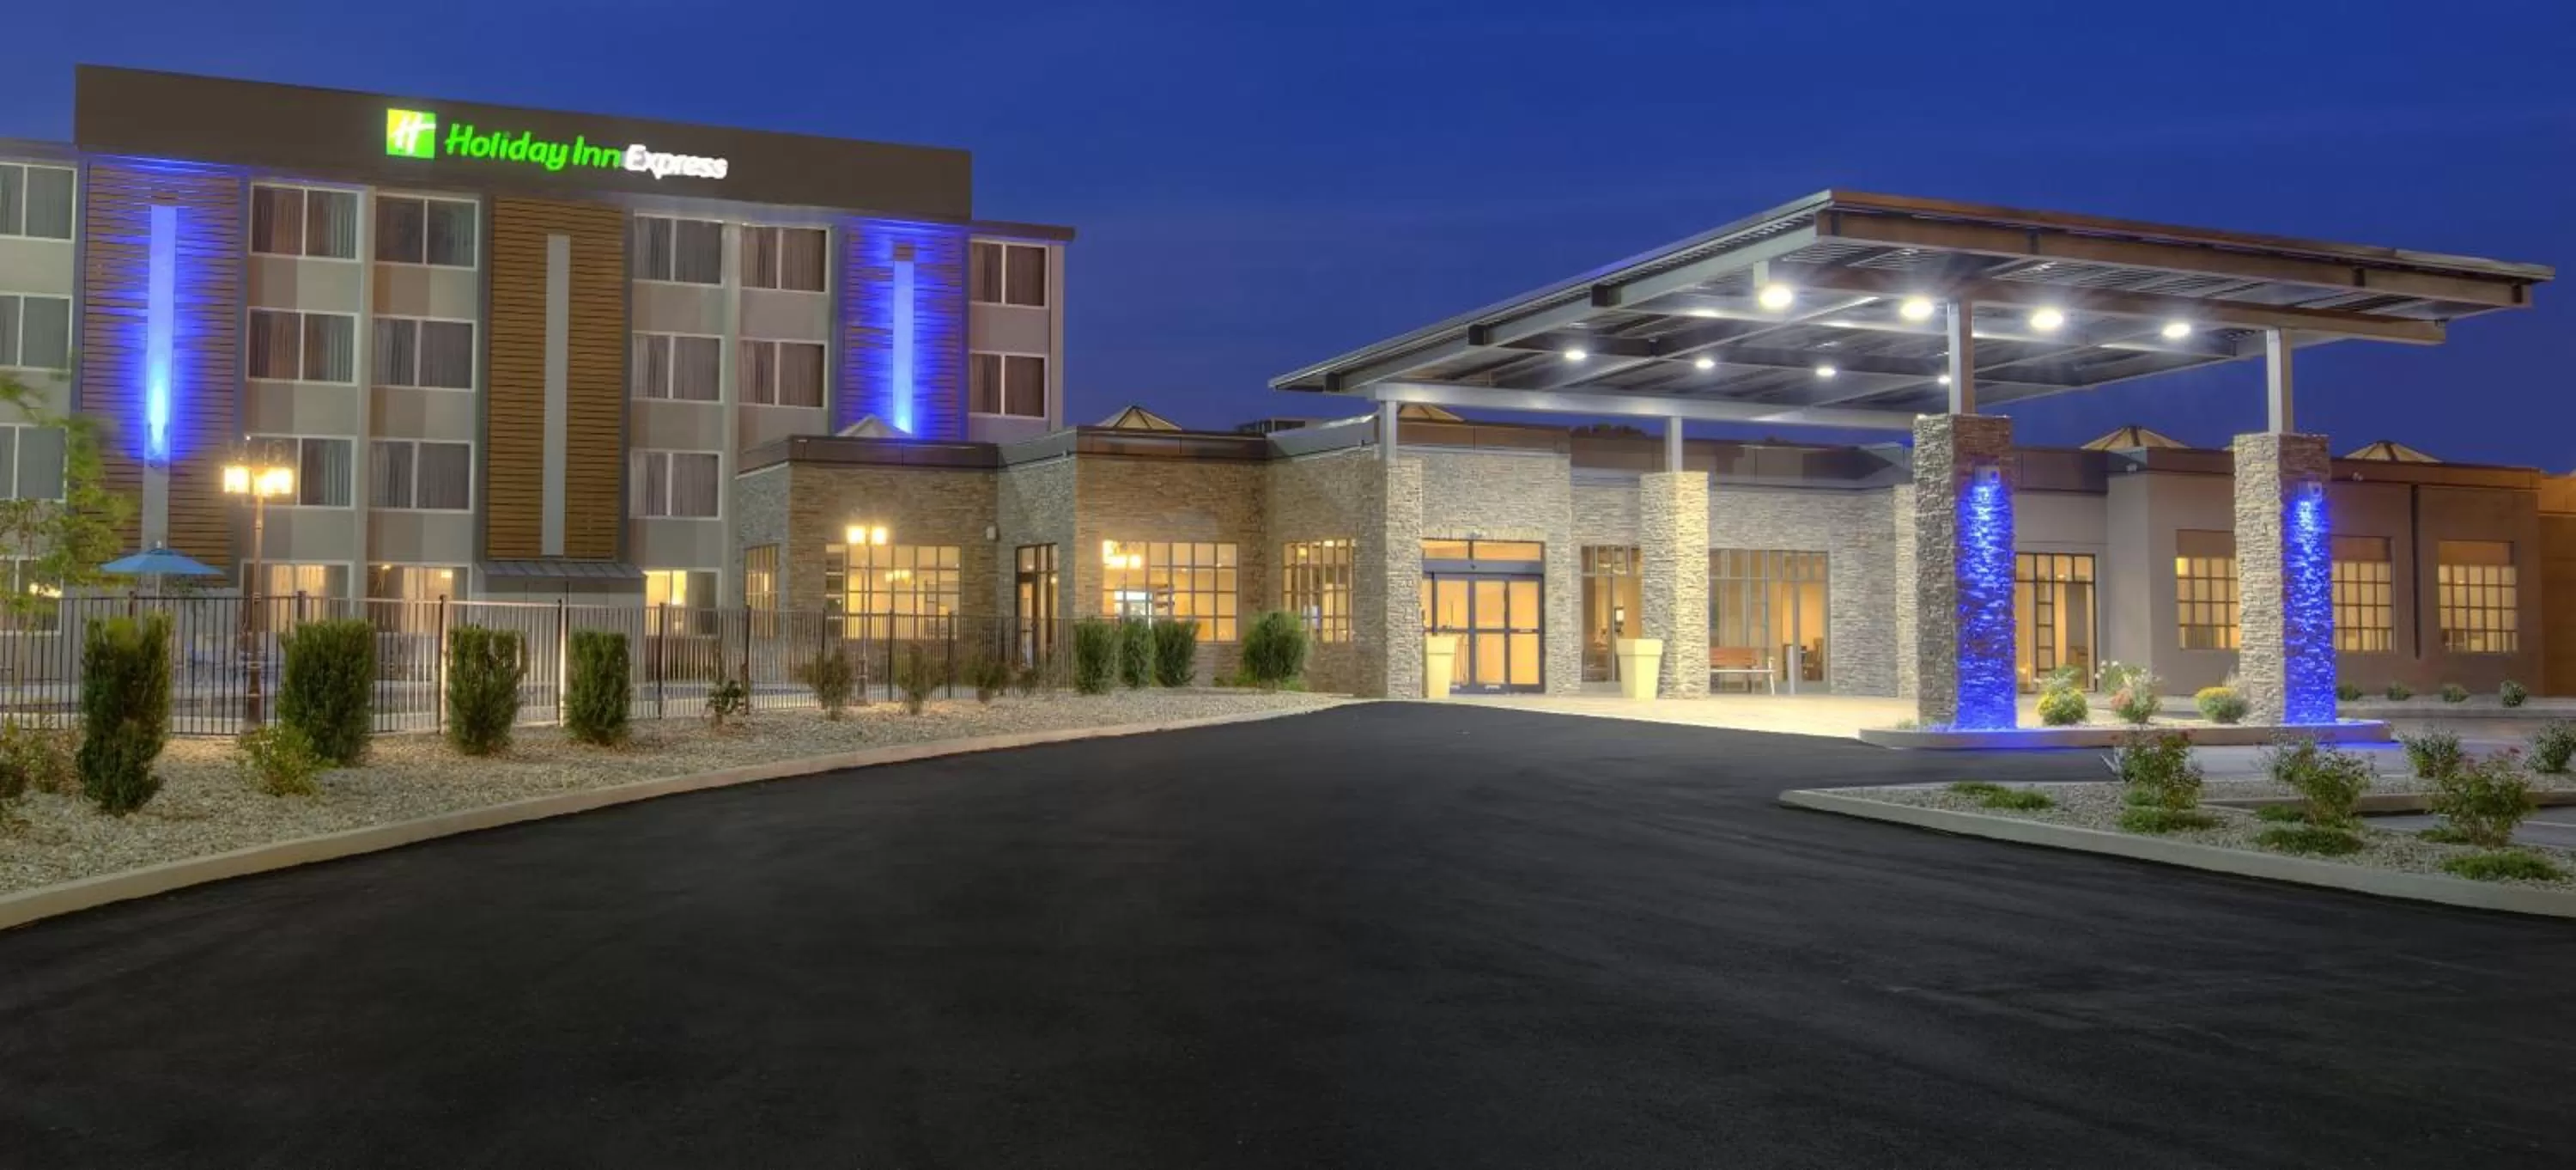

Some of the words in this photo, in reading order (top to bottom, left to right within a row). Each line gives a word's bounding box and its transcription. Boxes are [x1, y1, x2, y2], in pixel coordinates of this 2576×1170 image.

[445, 122, 568, 171] Holiday
[573, 135, 622, 168] Inn
[625, 143, 728, 180] Express
